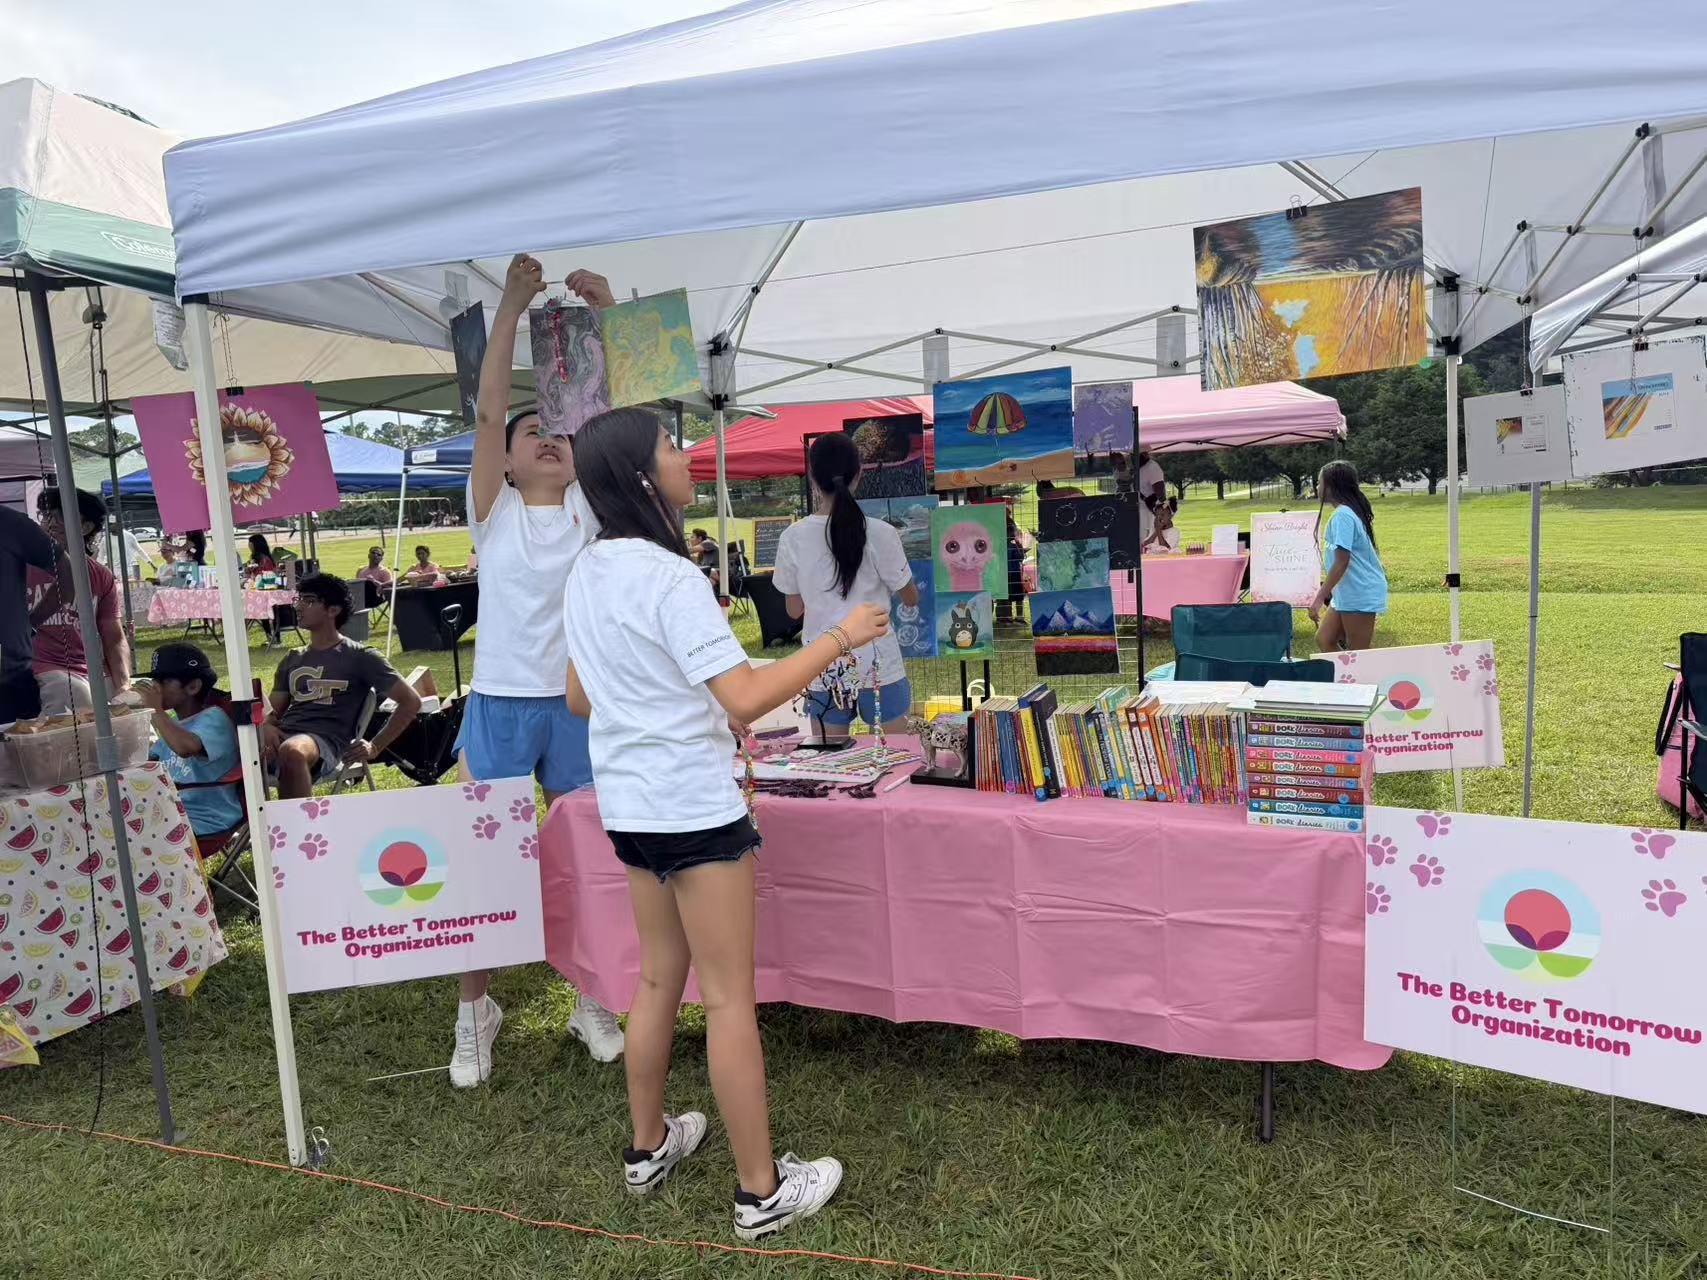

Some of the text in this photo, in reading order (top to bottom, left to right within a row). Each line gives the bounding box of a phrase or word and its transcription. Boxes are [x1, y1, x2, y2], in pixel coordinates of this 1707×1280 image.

[687, 645, 705, 657] BETTER
[289, 666, 349, 704] GT
[1365, 729, 1483, 743] Better Tomorrow
[297, 910, 517, 946] The Better Tomorrow
[344, 931, 474, 958] Organization
[1397, 972, 1702, 1044] The Better Tomorrow
[1451, 1004, 1631, 1056] Organization
